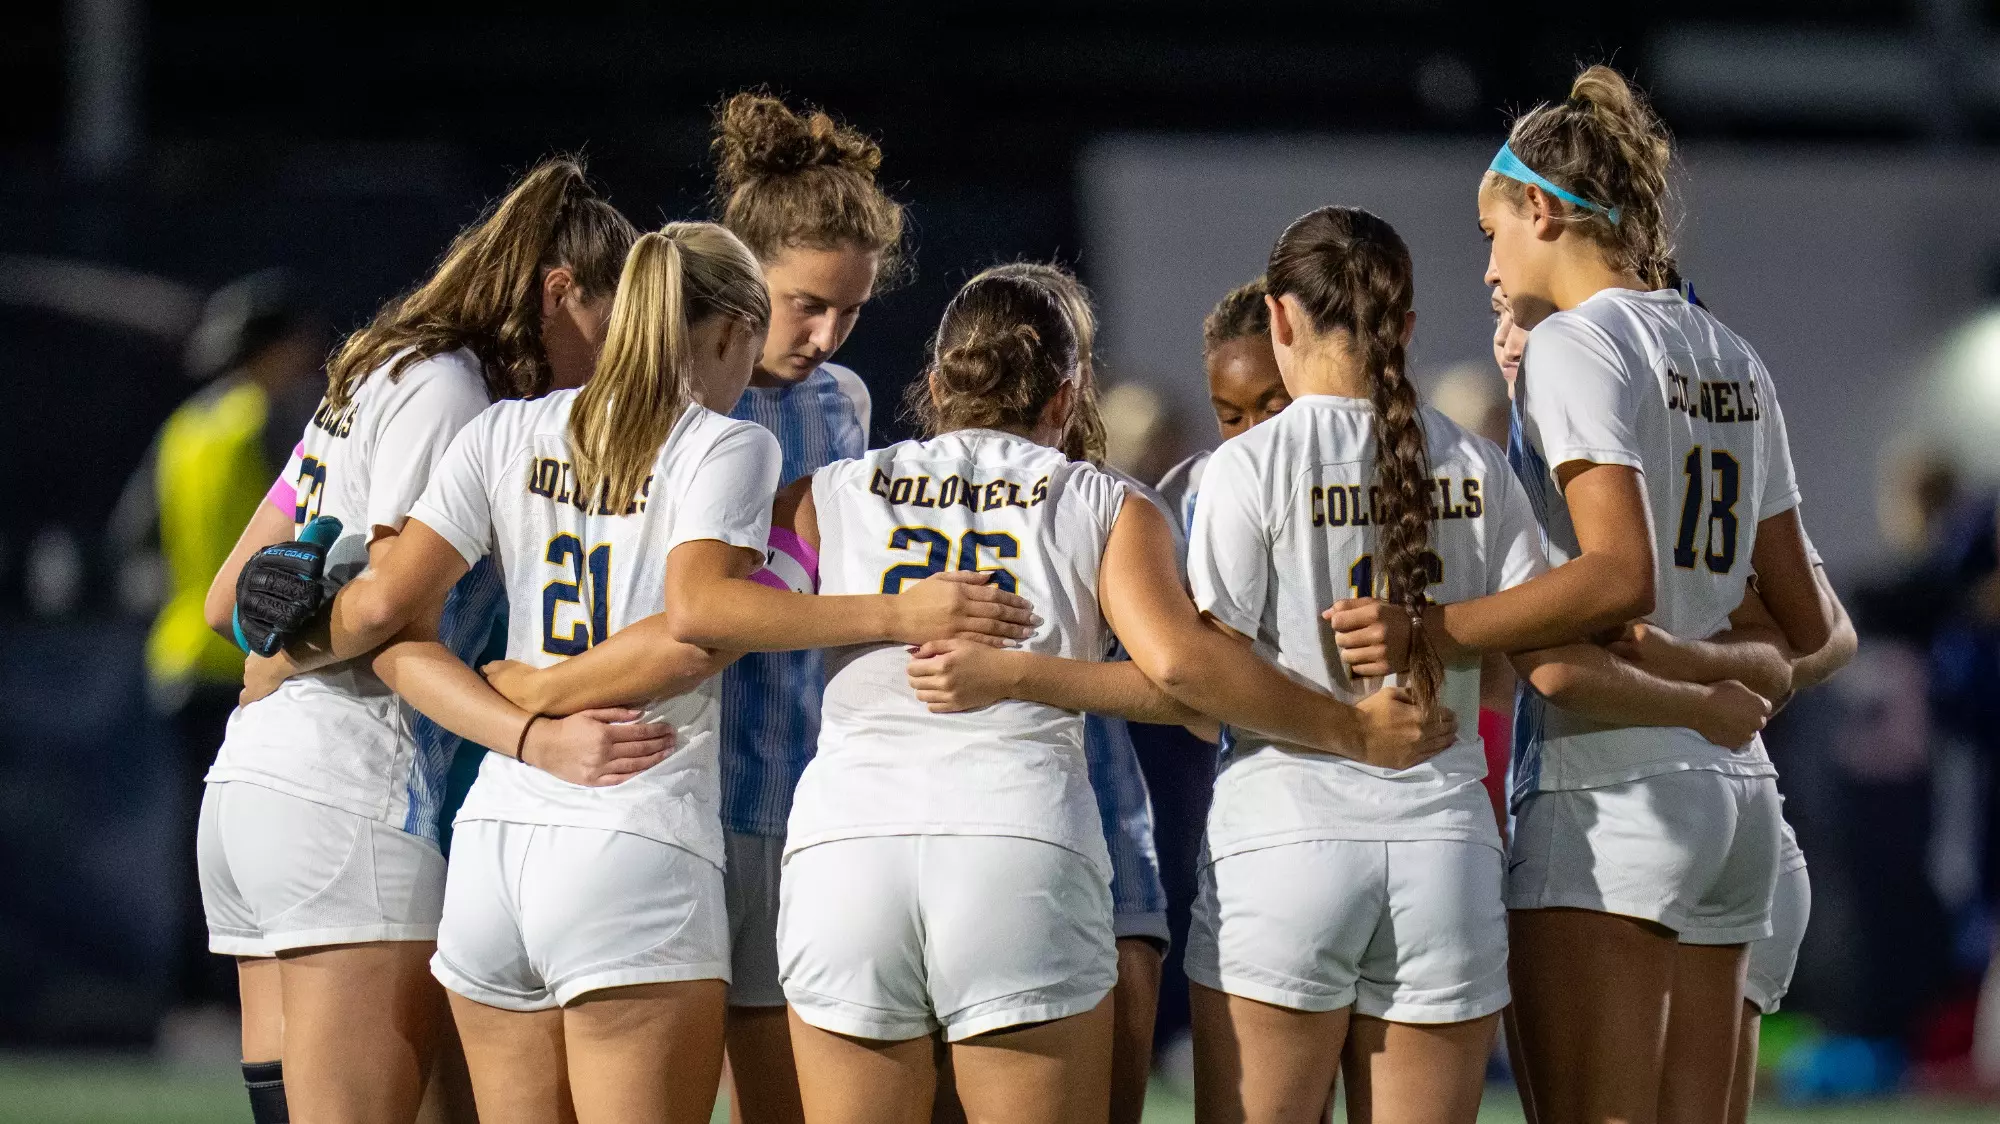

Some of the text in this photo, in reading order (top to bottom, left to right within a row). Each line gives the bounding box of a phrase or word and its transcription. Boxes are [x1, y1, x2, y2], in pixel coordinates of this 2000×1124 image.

[1667, 368, 1760, 423] COLNELS
[869, 465, 1049, 513] COLONELS
[1310, 477, 1484, 527] COLOELS
[1673, 443, 1741, 576] 18
[284, 549, 318, 562] COAST
[1347, 548, 1444, 605] 1
[541, 531, 613, 658] 21
